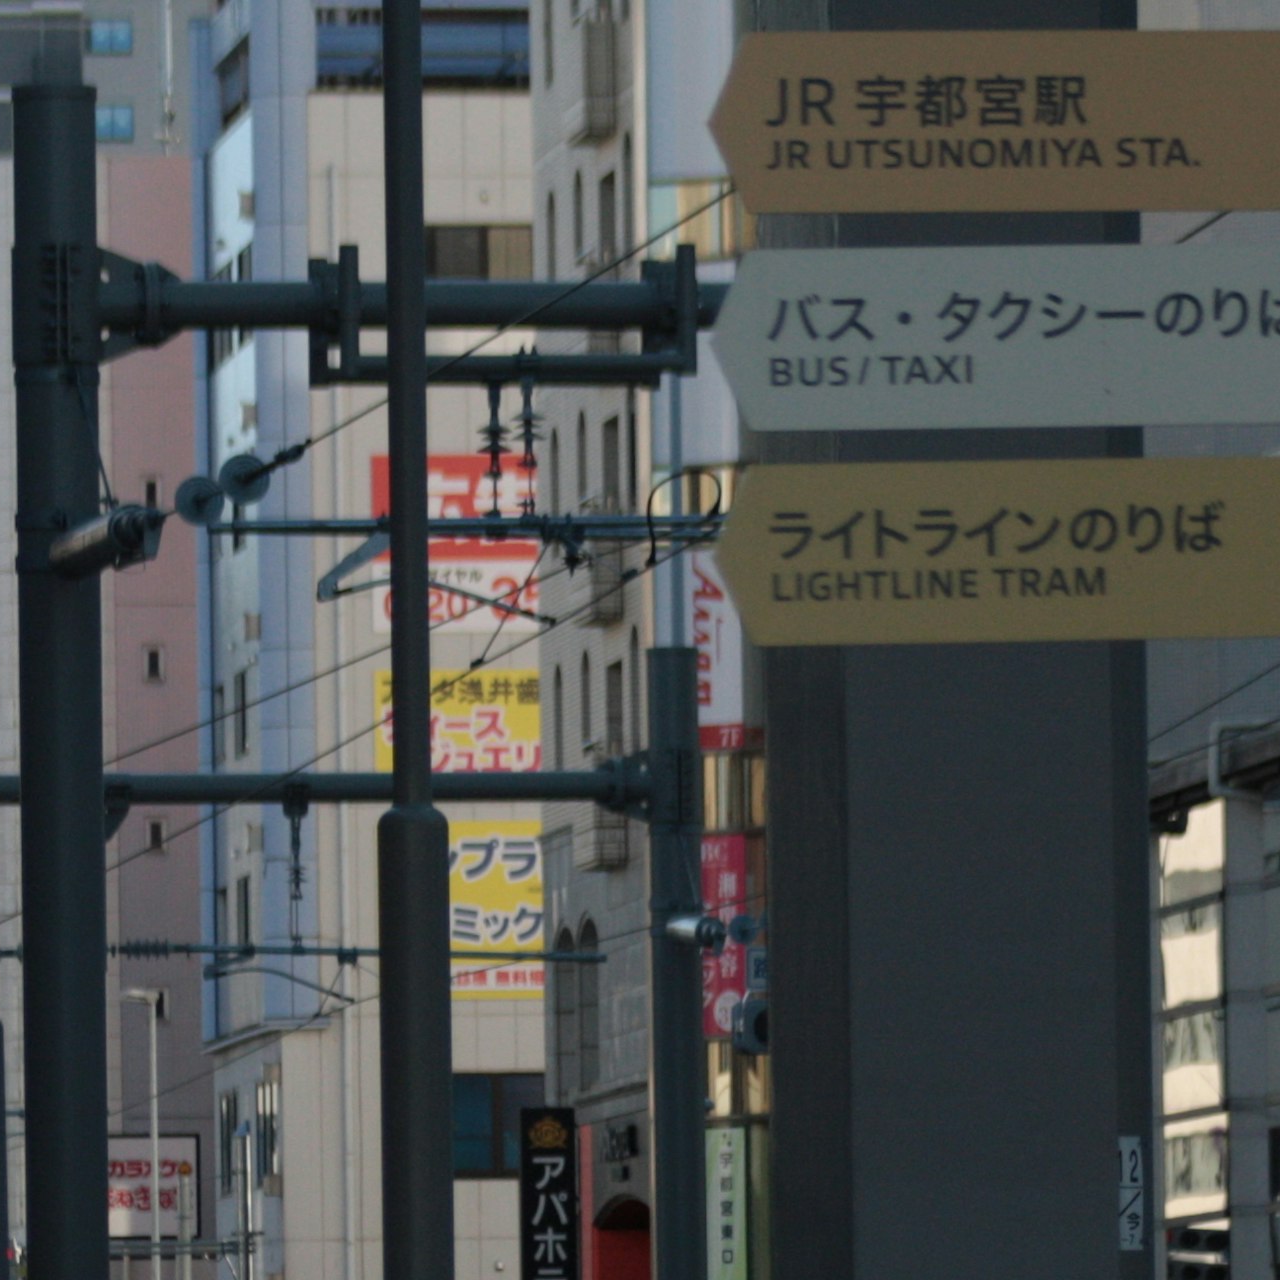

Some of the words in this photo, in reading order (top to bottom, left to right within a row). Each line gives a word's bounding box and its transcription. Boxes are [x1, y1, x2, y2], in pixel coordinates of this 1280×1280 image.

[767, 77, 835, 126] JR
[855, 75, 1087, 127] 宇都宮駅
[767, 140, 810, 169] JR
[826, 138, 1102, 168] UTSUNOMIYA
[1116, 137, 1201, 167] STA.
[770, 500, 1225, 559] ライトラインのりば
[773, 568, 980, 602] LIGHTLINE
[994, 567, 1107, 597] TRAM
[450, 838, 538, 880] プラ
